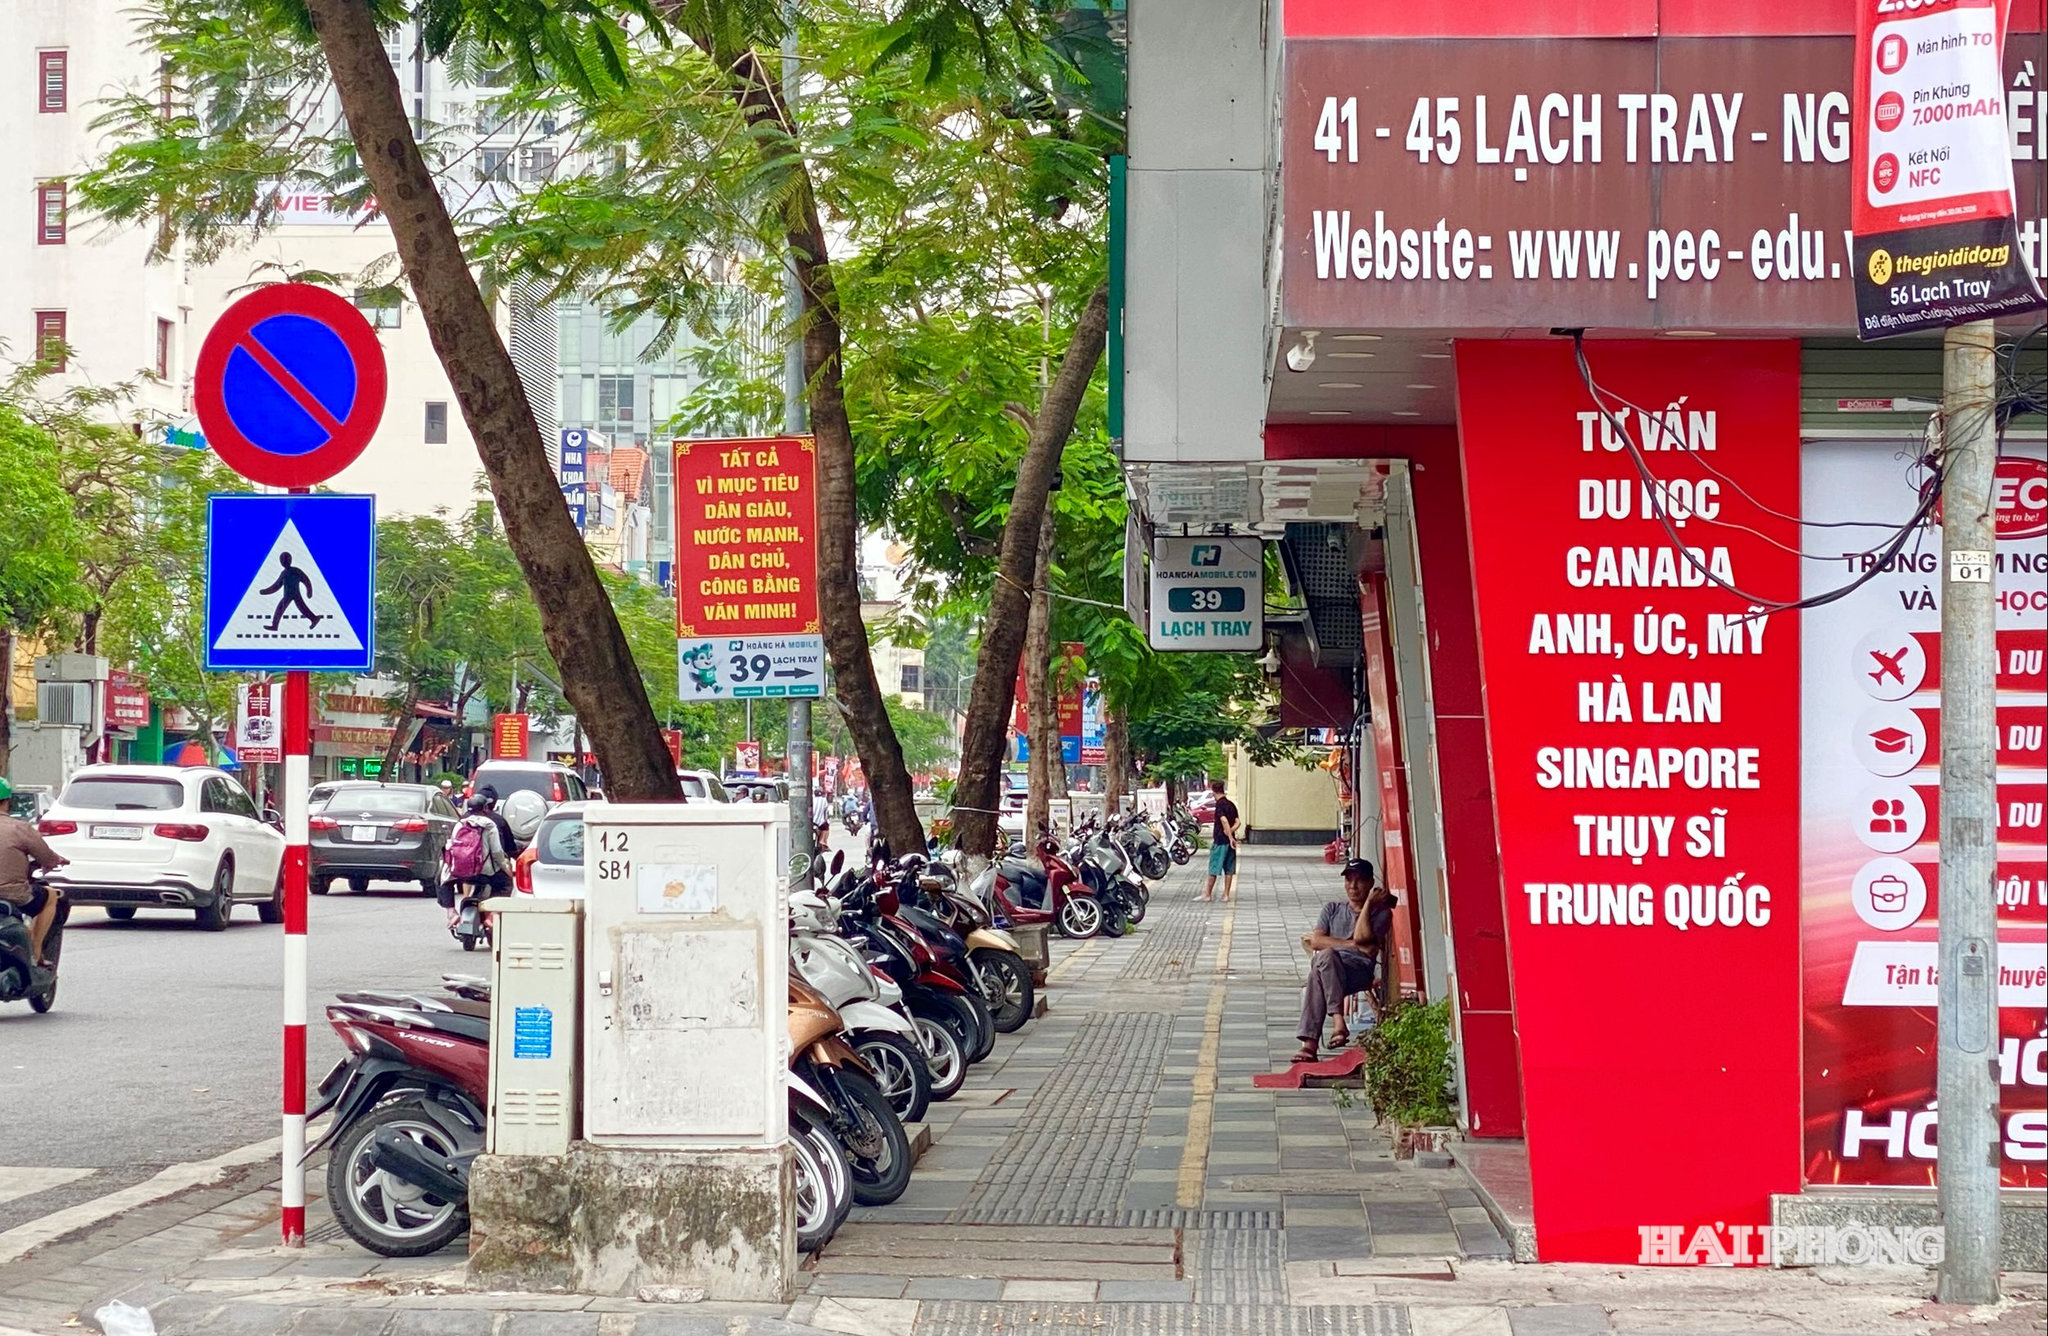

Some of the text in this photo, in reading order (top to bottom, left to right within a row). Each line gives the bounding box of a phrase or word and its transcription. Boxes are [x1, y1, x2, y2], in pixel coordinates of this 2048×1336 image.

[1916, 33, 1992, 56] Màn hình TO
[1912, 82, 1970, 104] Pin Khủng
[1912, 98, 2000, 126] 7.000 mAh
[1314, 97, 1358, 163] 41
[1375, 128, 1390, 137] -
[1406, 97, 1462, 164] 45
[1476, 93, 1602, 181] LẠCH
[1618, 92, 1744, 163] TRAY
[1908, 146, 1950, 166] Kết Nối
[1909, 167, 1941, 188] NFC
[1896, 244, 2010, 276] thegioididong
[1890, 278, 1991, 306] 56 Lạch Tray
[1900, 310, 1923, 326] Nam
[1952, 303, 1978, 319] Hotel
[1576, 396, 1717, 452] TƯ VẤN
[564, 451, 583, 466] NHA
[719, 446, 780, 468] TẤT CẢ
[562, 470, 585, 484] KHOA
[696, 473, 800, 497] VÌ MỤC TIÊU
[705, 498, 792, 520] DÂN GIÀU,
[1579, 479, 1720, 528] DU HỌC
[2013, 512, 2022, 521] to
[2024, 510, 2040, 522] be!
[694, 526, 804, 546] NƯỚC MẠNH,
[709, 547, 790, 571] DÂN CHỦ,
[1566, 546, 1736, 588] CANADA
[700, 572, 801, 596] CÔNG BẰNG
[1156, 570, 1257, 580] HOANGHAMOBILE.COM
[1960, 566, 1983, 580] 01
[1191, 590, 1222, 610] 39
[1899, 585, 1938, 611] VÀ
[704, 602, 797, 621] VĂN MINH!
[1160, 621, 1253, 640] LẠCH TRAY
[1528, 605, 1769, 660] ANH, ÚC, MỸ
[788, 640, 819, 650] MOBILE
[729, 654, 818, 683] 39 LẠCH TRAY
[2009, 650, 2043, 675] DU
[1578, 674, 1722, 723] HÀ LAN
[2009, 725, 2043, 750] DU
[1536, 747, 1761, 789] SINGAPORE
[2008, 802, 2043, 827] DU
[599, 831, 630, 853] 1.2
[1573, 807, 1729, 865] THỤY SĨ
[598, 860, 631, 880] SB1
[1524, 871, 1772, 931] TRUNG QUỐC
[1886, 965, 1920, 989] Tận
[397, 1031, 456, 1048] VISION
